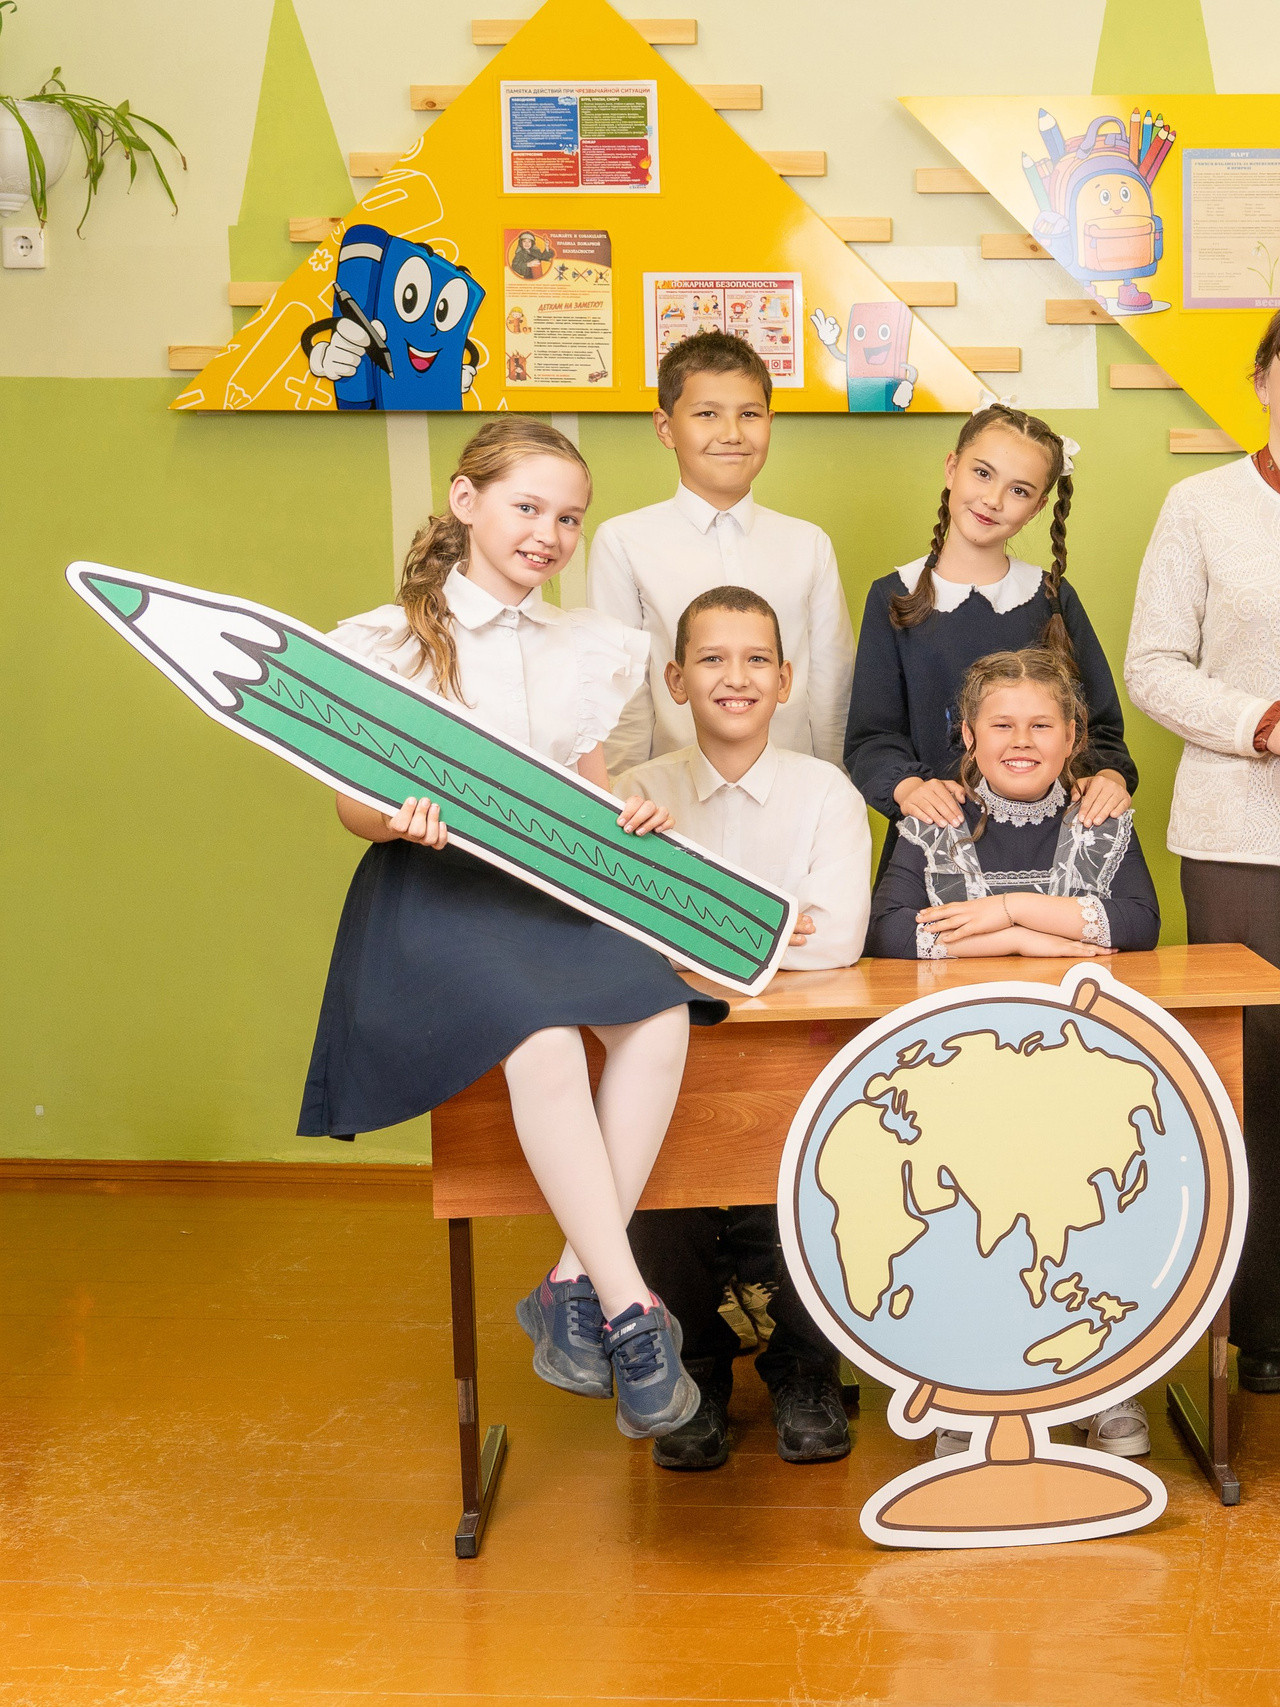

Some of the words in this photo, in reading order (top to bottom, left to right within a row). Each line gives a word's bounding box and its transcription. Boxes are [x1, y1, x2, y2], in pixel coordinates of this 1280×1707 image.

[671, 280, 714, 288] ПОЖАРНАЯ
[715, 280, 778, 288] БЕЗОПАСНОСТЬ
[538, 302, 563, 311] ДЕТКАМ
